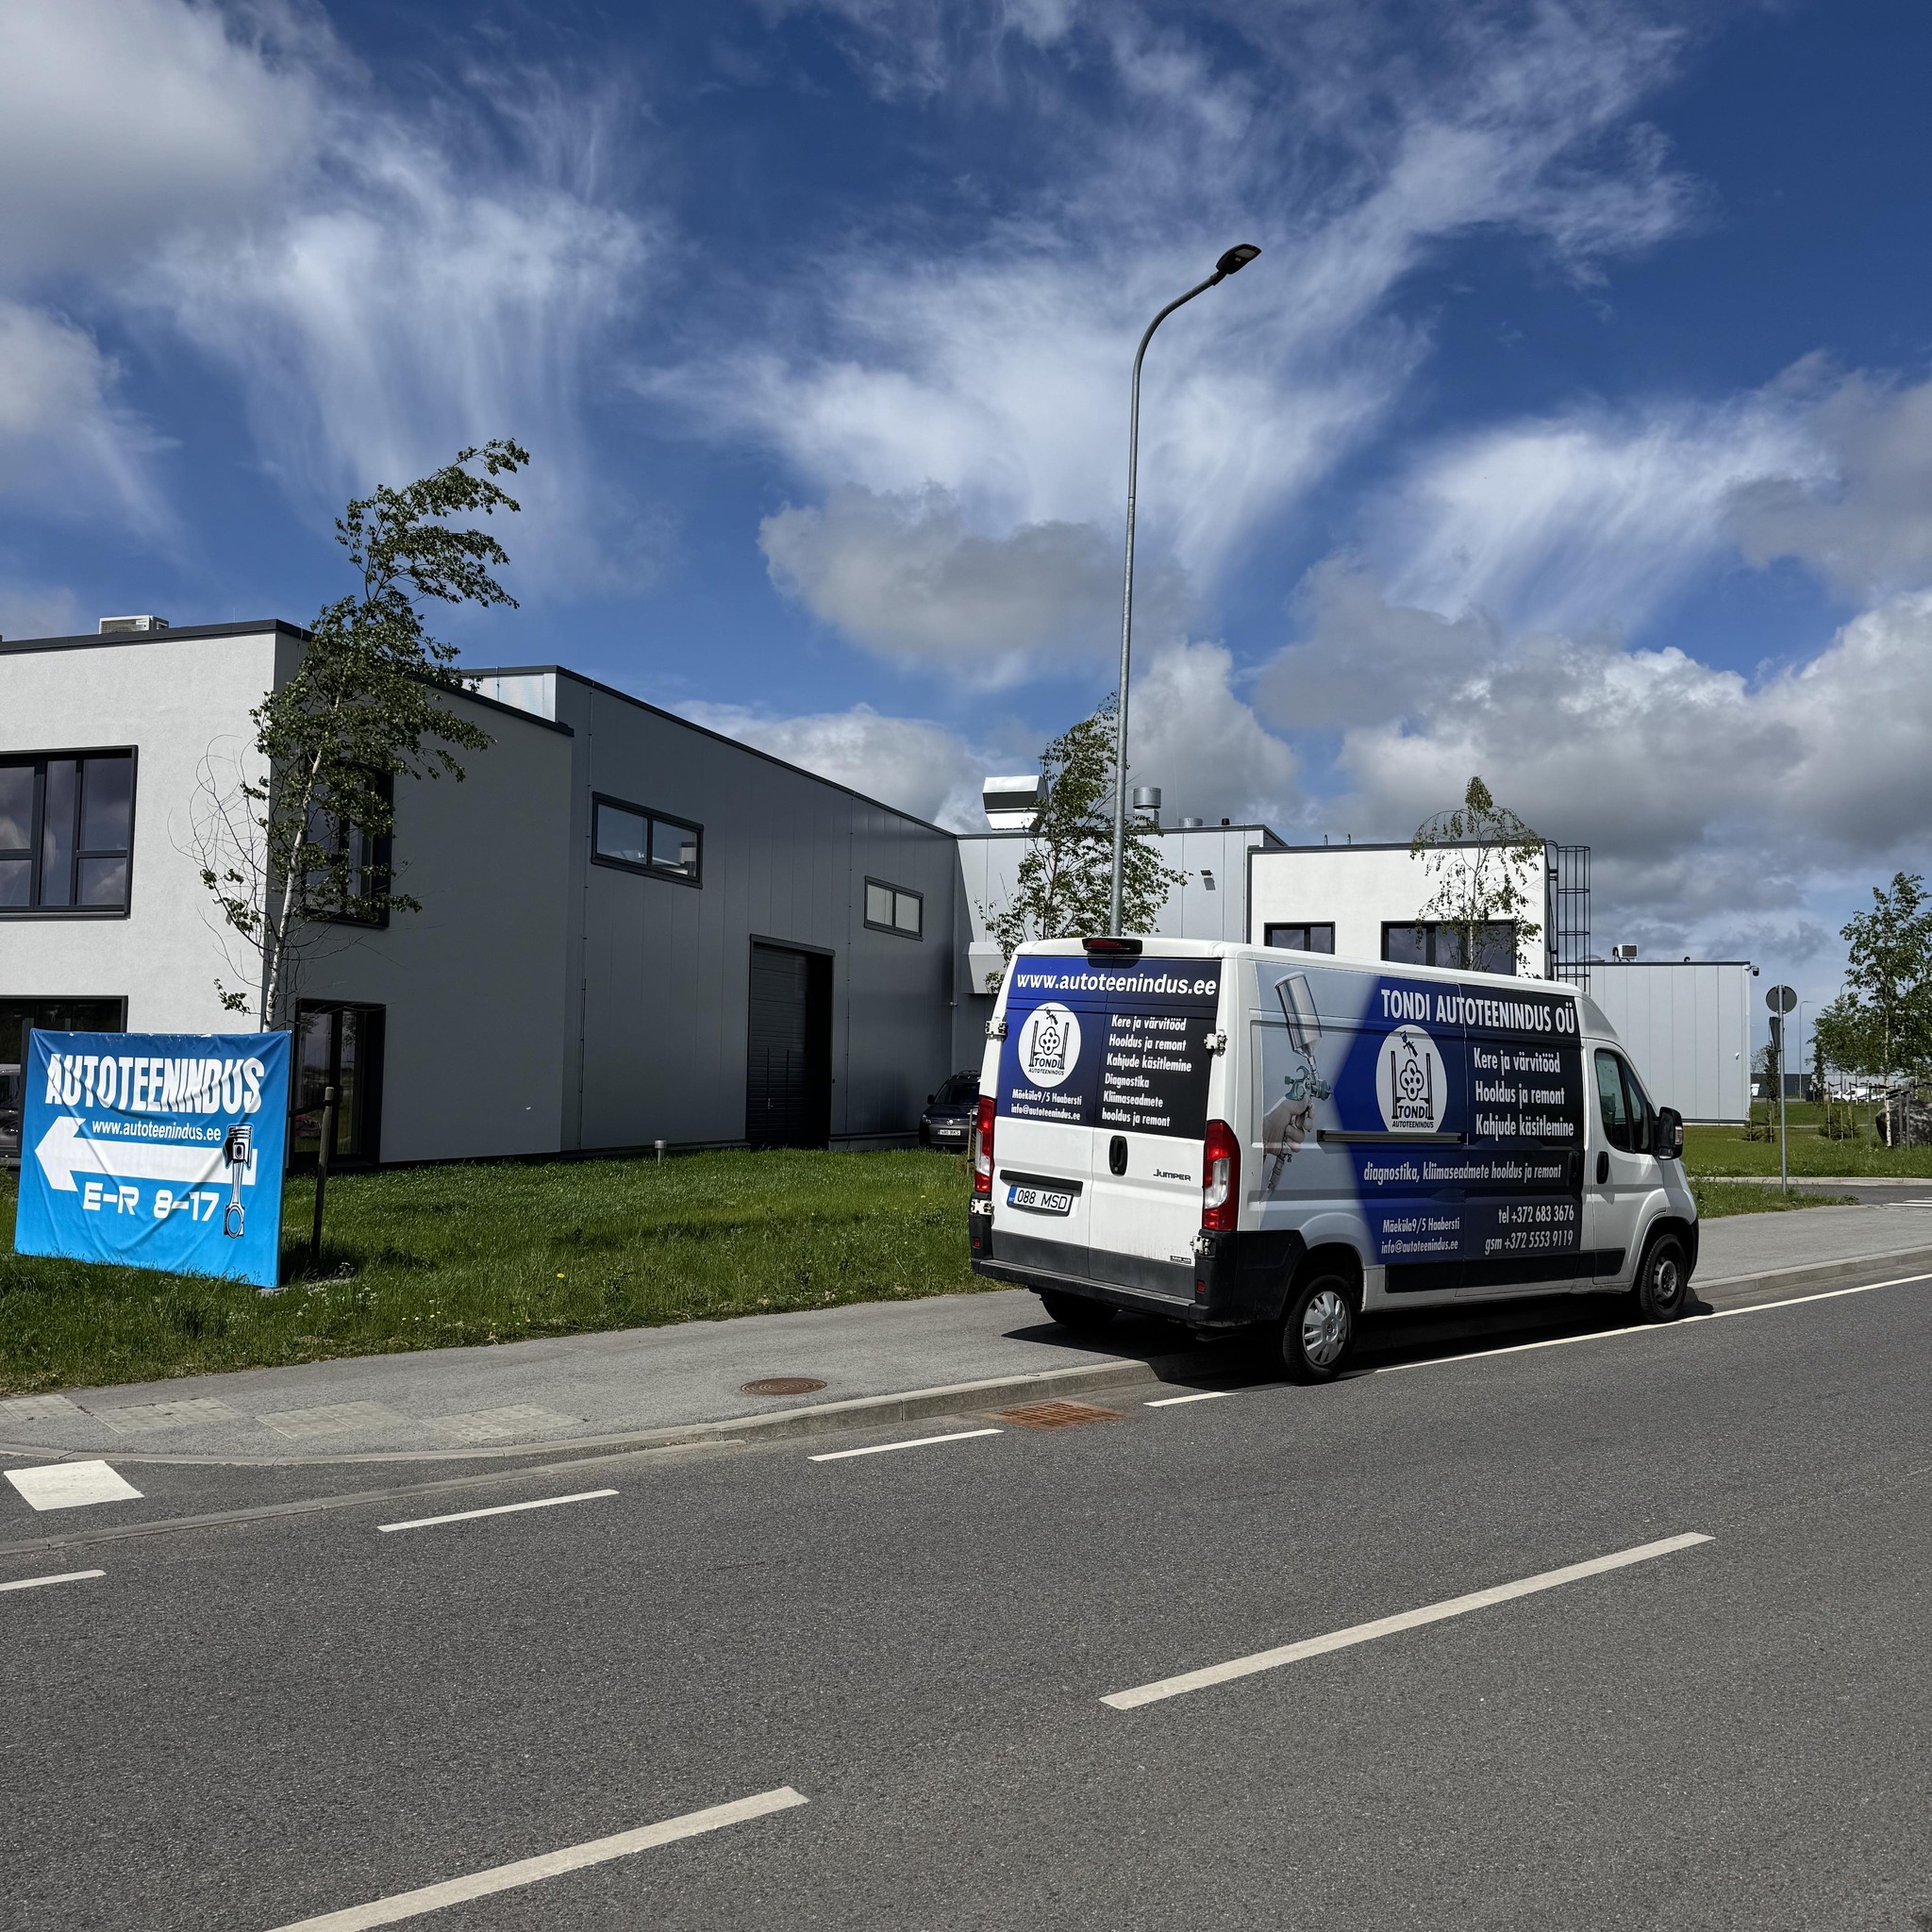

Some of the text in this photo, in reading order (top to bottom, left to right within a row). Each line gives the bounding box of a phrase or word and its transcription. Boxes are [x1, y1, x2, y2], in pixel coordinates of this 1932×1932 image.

[1017, 973, 1216, 996] www.autoteenindus.ee
[1381, 989, 1575, 1034] TONDI AUTOTEENINDUS OÜ
[1111, 1014, 1187, 1030] Kere ja värvitööd
[1109, 1034, 1187, 1051] Hooldus ja remont
[1035, 1058, 1060, 1068] TONDI
[1107, 1053, 1192, 1072] Kahjude käsitlemine
[1474, 1047, 1560, 1075] Kere ja värvitööd
[45, 1054, 264, 1114] AUTOTEENINDUS
[1105, 1074, 1149, 1089] Diagnostika
[1052, 1092, 1083, 1106] Haabersti
[1104, 1091, 1163, 1108] Kliimaseadmete
[1475, 1080, 1564, 1109] Hooldus ja remont
[1011, 1104, 1081, 1121] info@autoteenindus.ee
[1102, 1108, 1170, 1126] hooldus ja remont
[1398, 1106, 1428, 1119] TONDI
[92, 1121, 221, 1141] www.autoteenindus.ee
[1475, 1113, 1574, 1141] Kahjude käsitlemine
[1364, 1161, 1562, 1185] diagnostika, kliimaseadmete hooldus ja remont
[1017, 1189, 1068, 1209] 088 MSD
[1428, 1217, 1460, 1230] Haabersti
[1498, 1205, 1574, 1224] tel +372 683 3676
[1381, 1238, 1458, 1255] info@autoteenindus.ee
[1485, 1230, 1574, 1255] gsm +372 5553 9119
